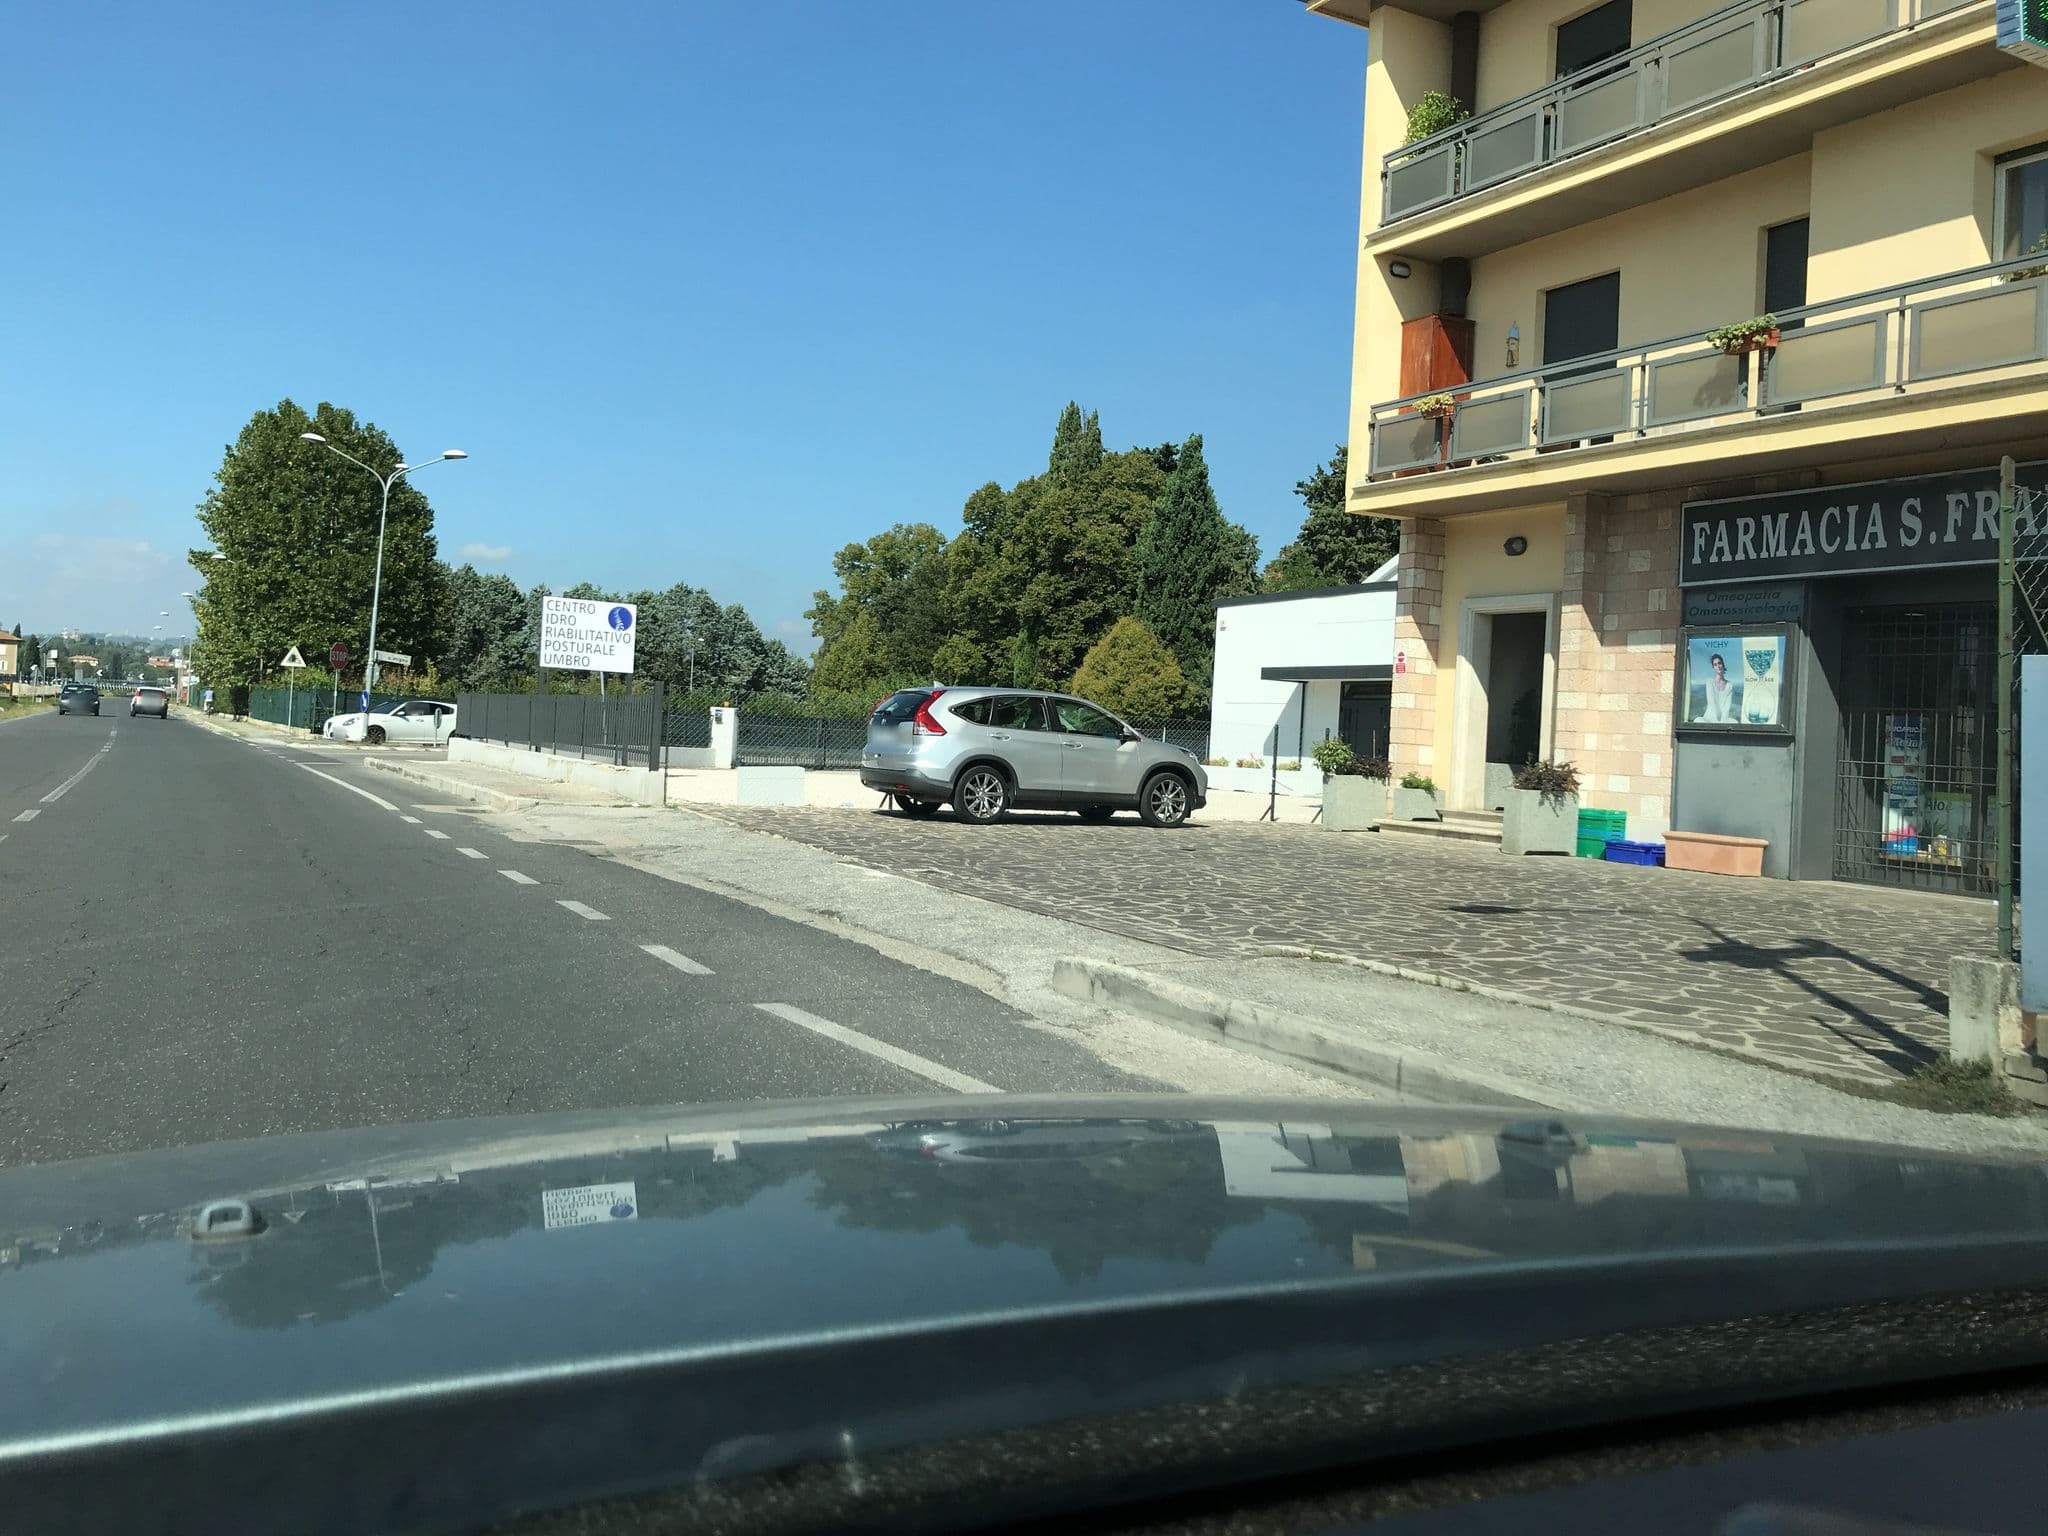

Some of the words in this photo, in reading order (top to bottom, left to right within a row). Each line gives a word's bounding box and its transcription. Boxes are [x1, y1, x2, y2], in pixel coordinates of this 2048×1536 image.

[1691, 502, 1887, 565] FARMACIA
[1706, 591, 1780, 602] Omeopatia
[546, 600, 596, 614] CENTRO
[546, 613, 577, 625] IDRO
[545, 626, 631, 644] RIABILITATIVO
[544, 639, 615, 656] POSTURALE
[1704, 640, 1729, 649] VICHY
[331, 651, 347, 661] STOP
[544, 653, 590, 667] UMBRO
